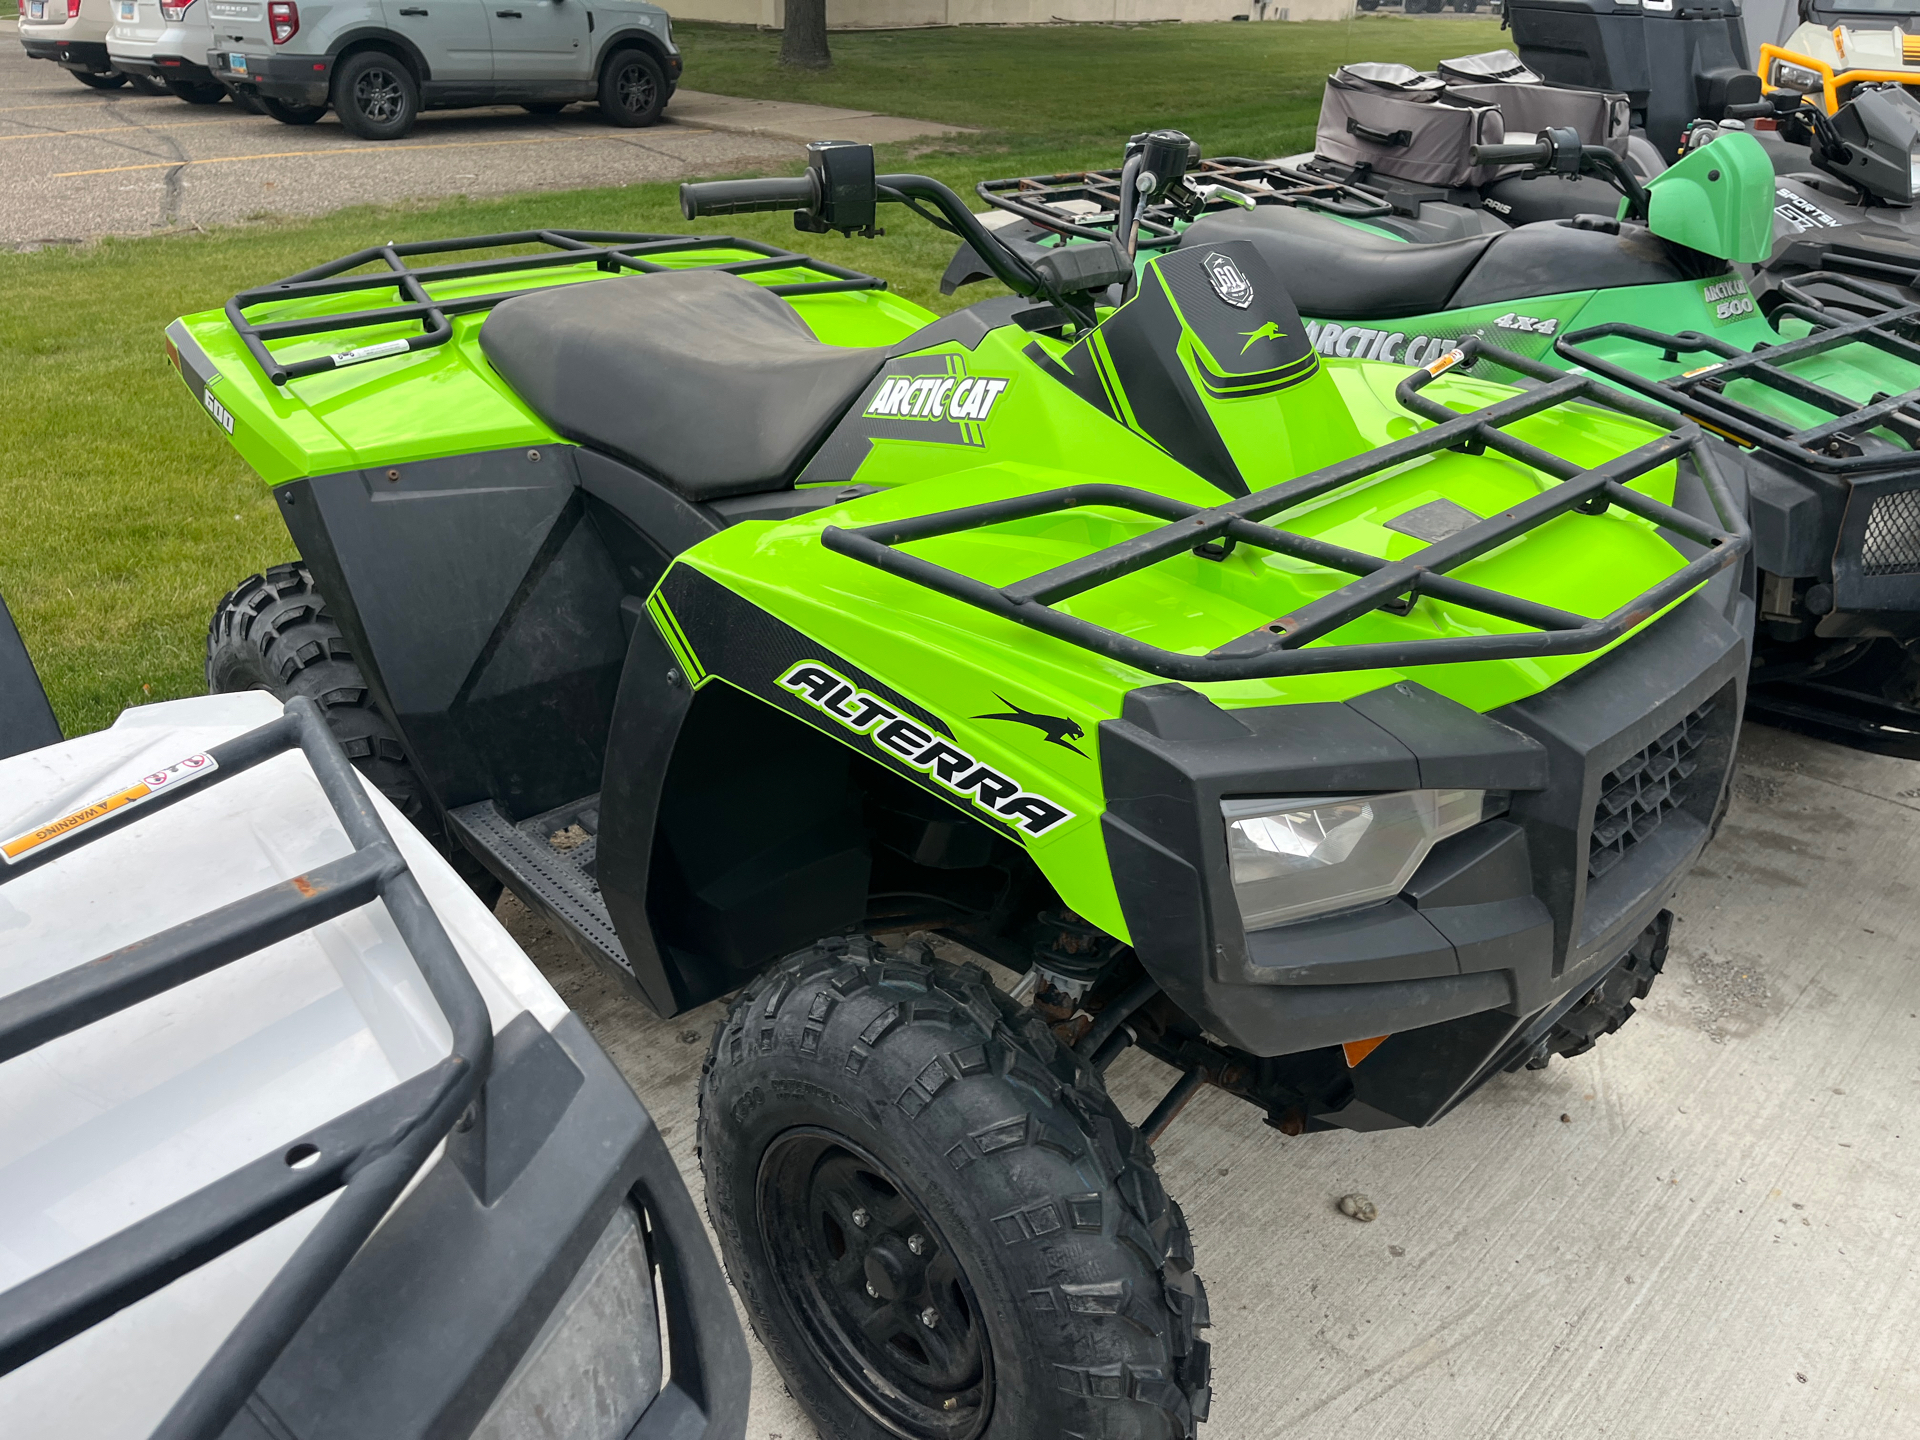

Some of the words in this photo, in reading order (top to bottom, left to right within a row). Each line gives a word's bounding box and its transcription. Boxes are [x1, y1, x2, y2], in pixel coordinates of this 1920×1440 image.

[1482, 198, 1512, 214] ARIS
[1704, 280, 1736, 302] ARCTIC
[1717, 298, 1753, 319] 500
[1305, 320, 1405, 364] ARCTIC
[1404, 335, 1458, 368] CAT
[205, 388, 234, 435] 600
[866, 377, 954, 418] ARCTIC
[949, 377, 1008, 420] CAT
[780, 663, 1076, 838] ALTERRA
[36, 808, 99, 840] WARNING
